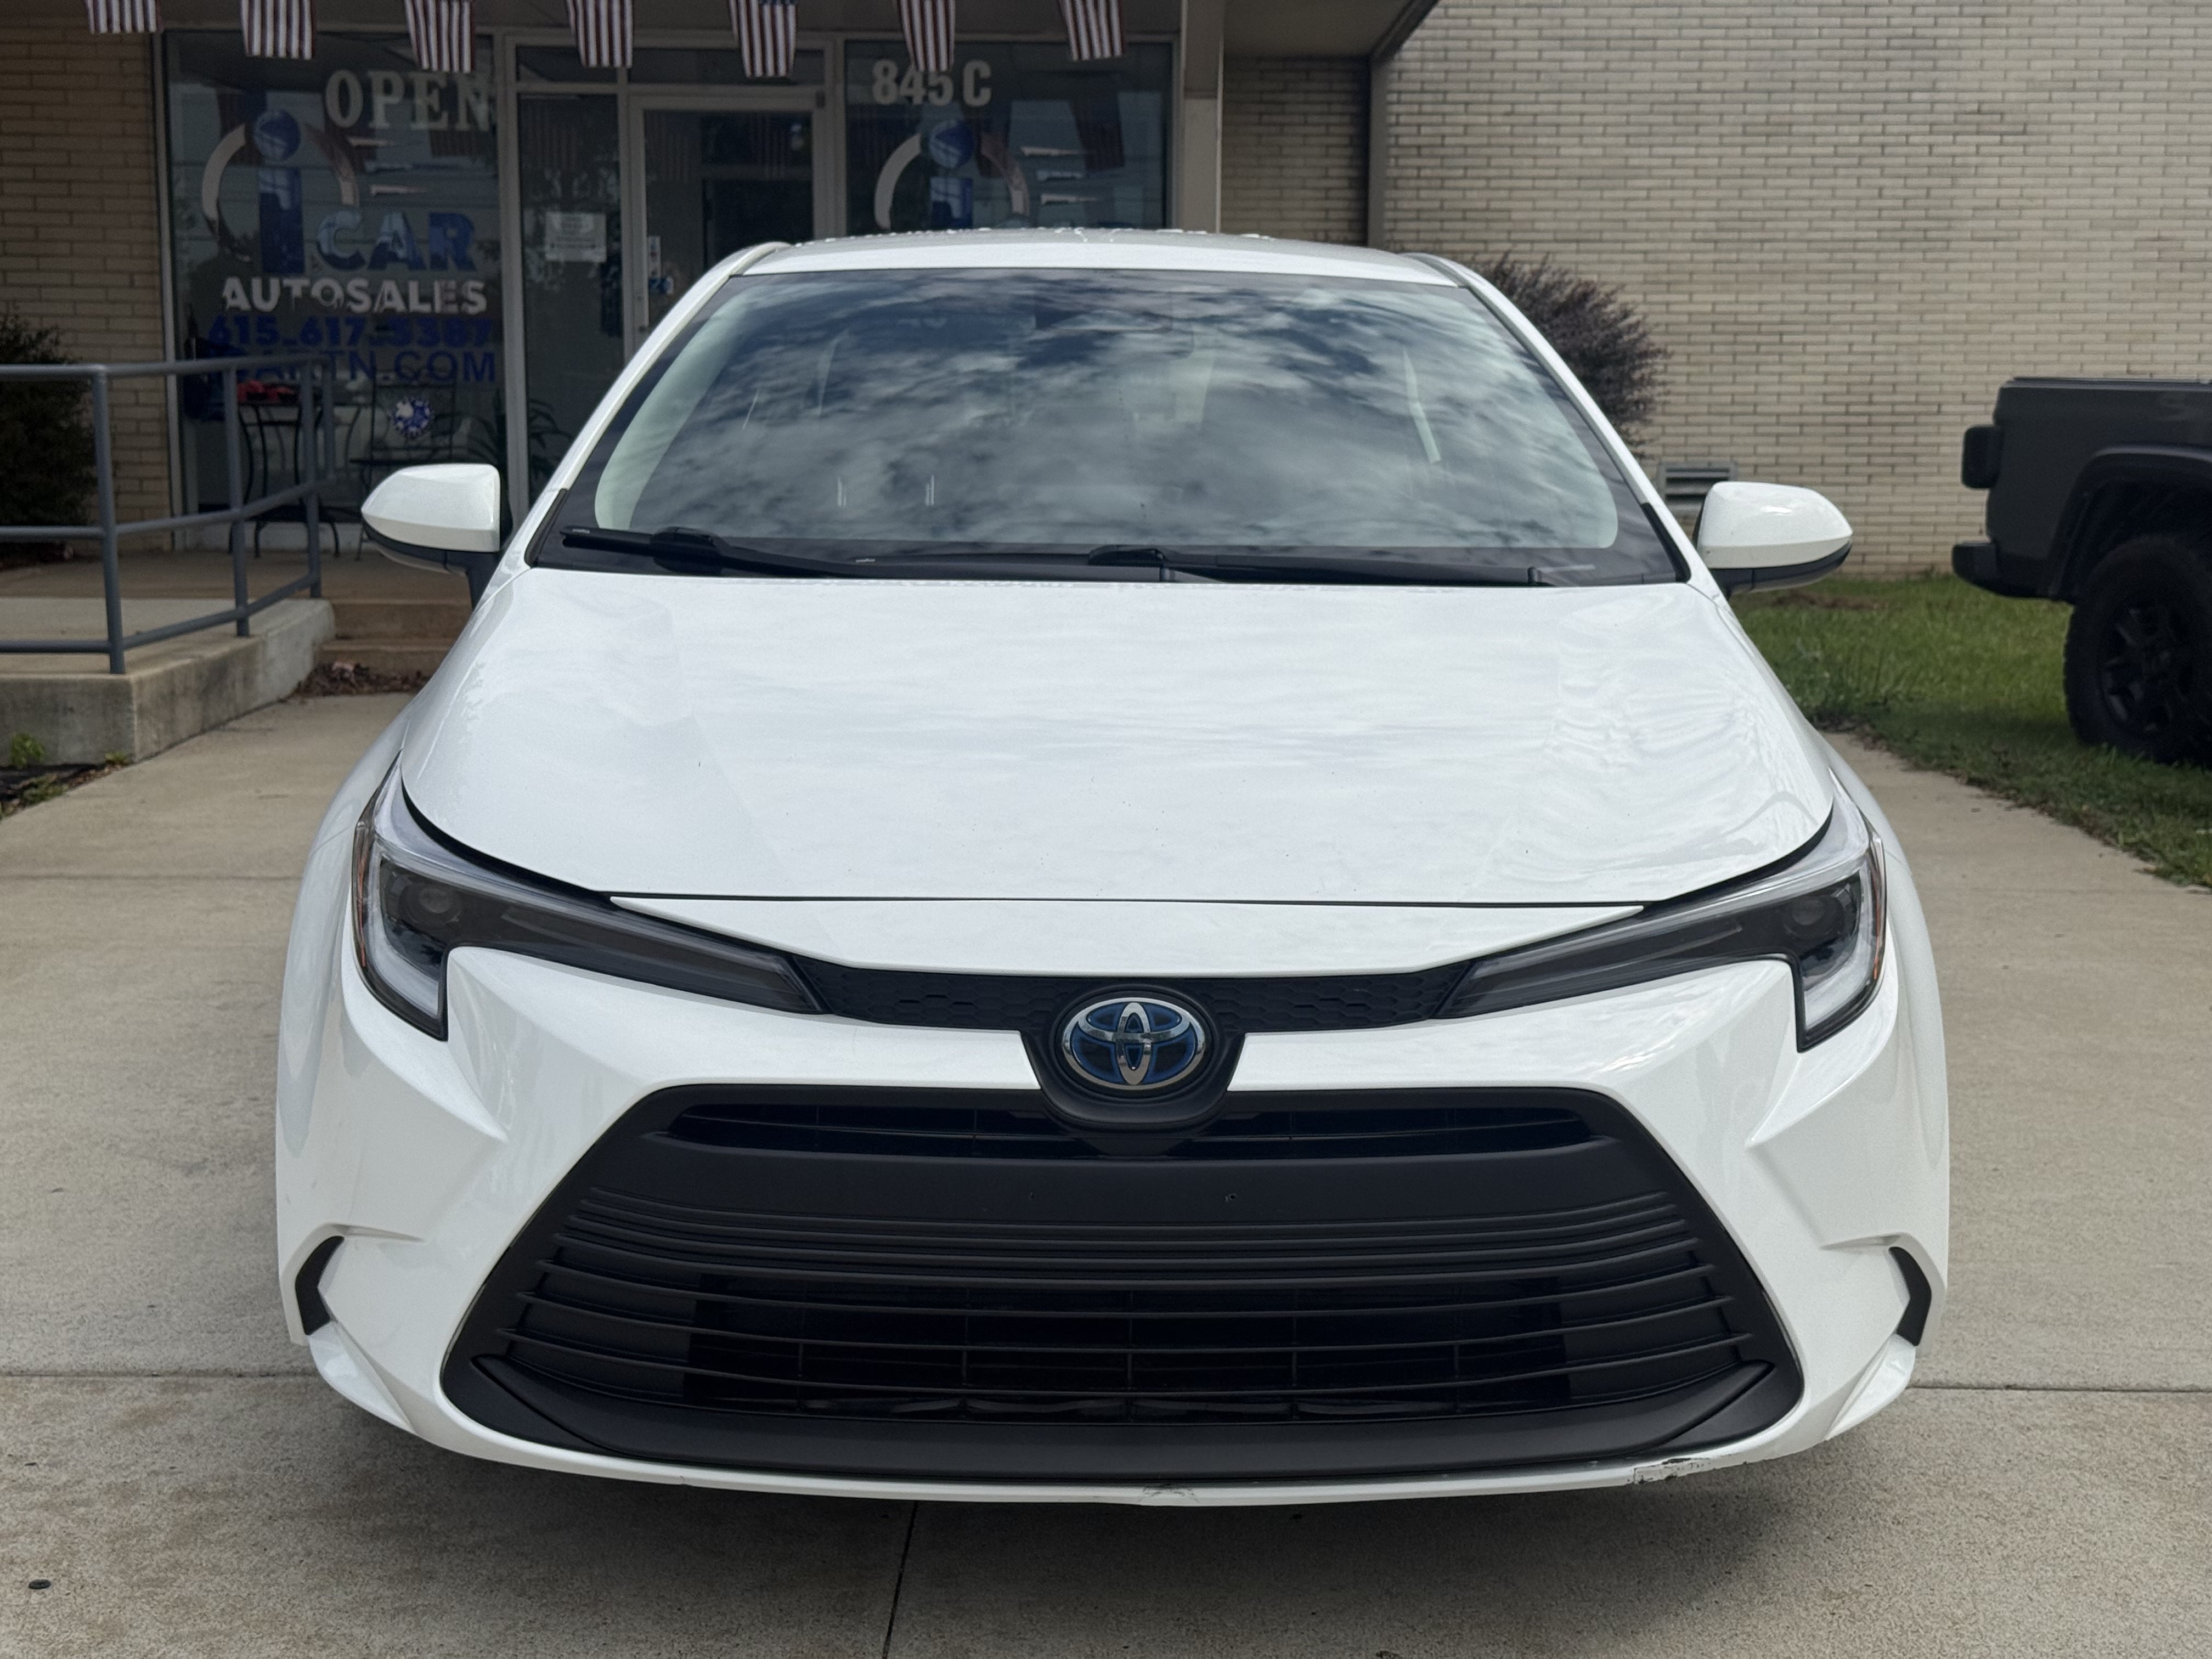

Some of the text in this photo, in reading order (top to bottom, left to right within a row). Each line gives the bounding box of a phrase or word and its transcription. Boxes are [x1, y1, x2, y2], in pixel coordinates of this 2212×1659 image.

[325, 70, 493, 131] OPEN
[872, 59, 992, 107] 845 C
[222, 277, 488, 314] AUTOSALES
